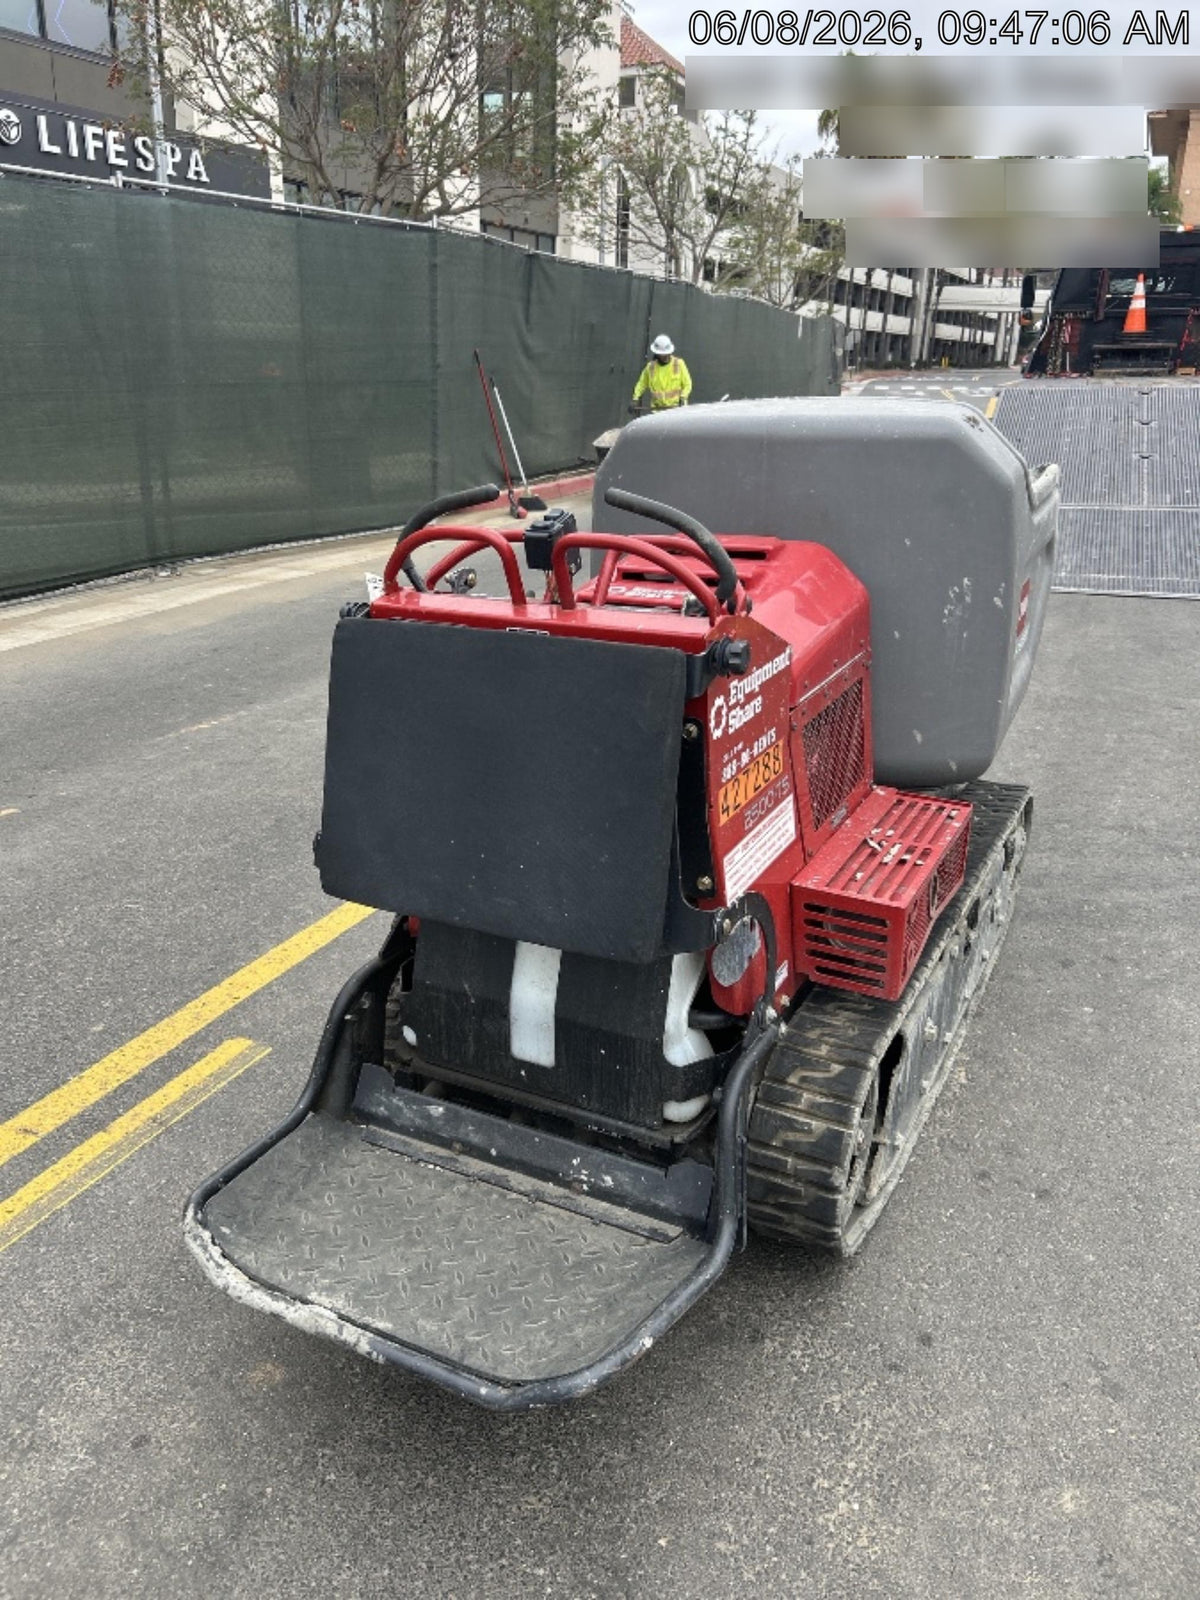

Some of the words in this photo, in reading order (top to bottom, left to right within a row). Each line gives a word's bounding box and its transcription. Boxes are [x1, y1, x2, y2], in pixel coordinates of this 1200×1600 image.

[36, 114, 129, 168] LIFE
[134, 135, 211, 184] SPA
[729, 645, 791, 706] Equipment
[728, 695, 762, 735] Share
[721, 743, 781, 817] 427288
